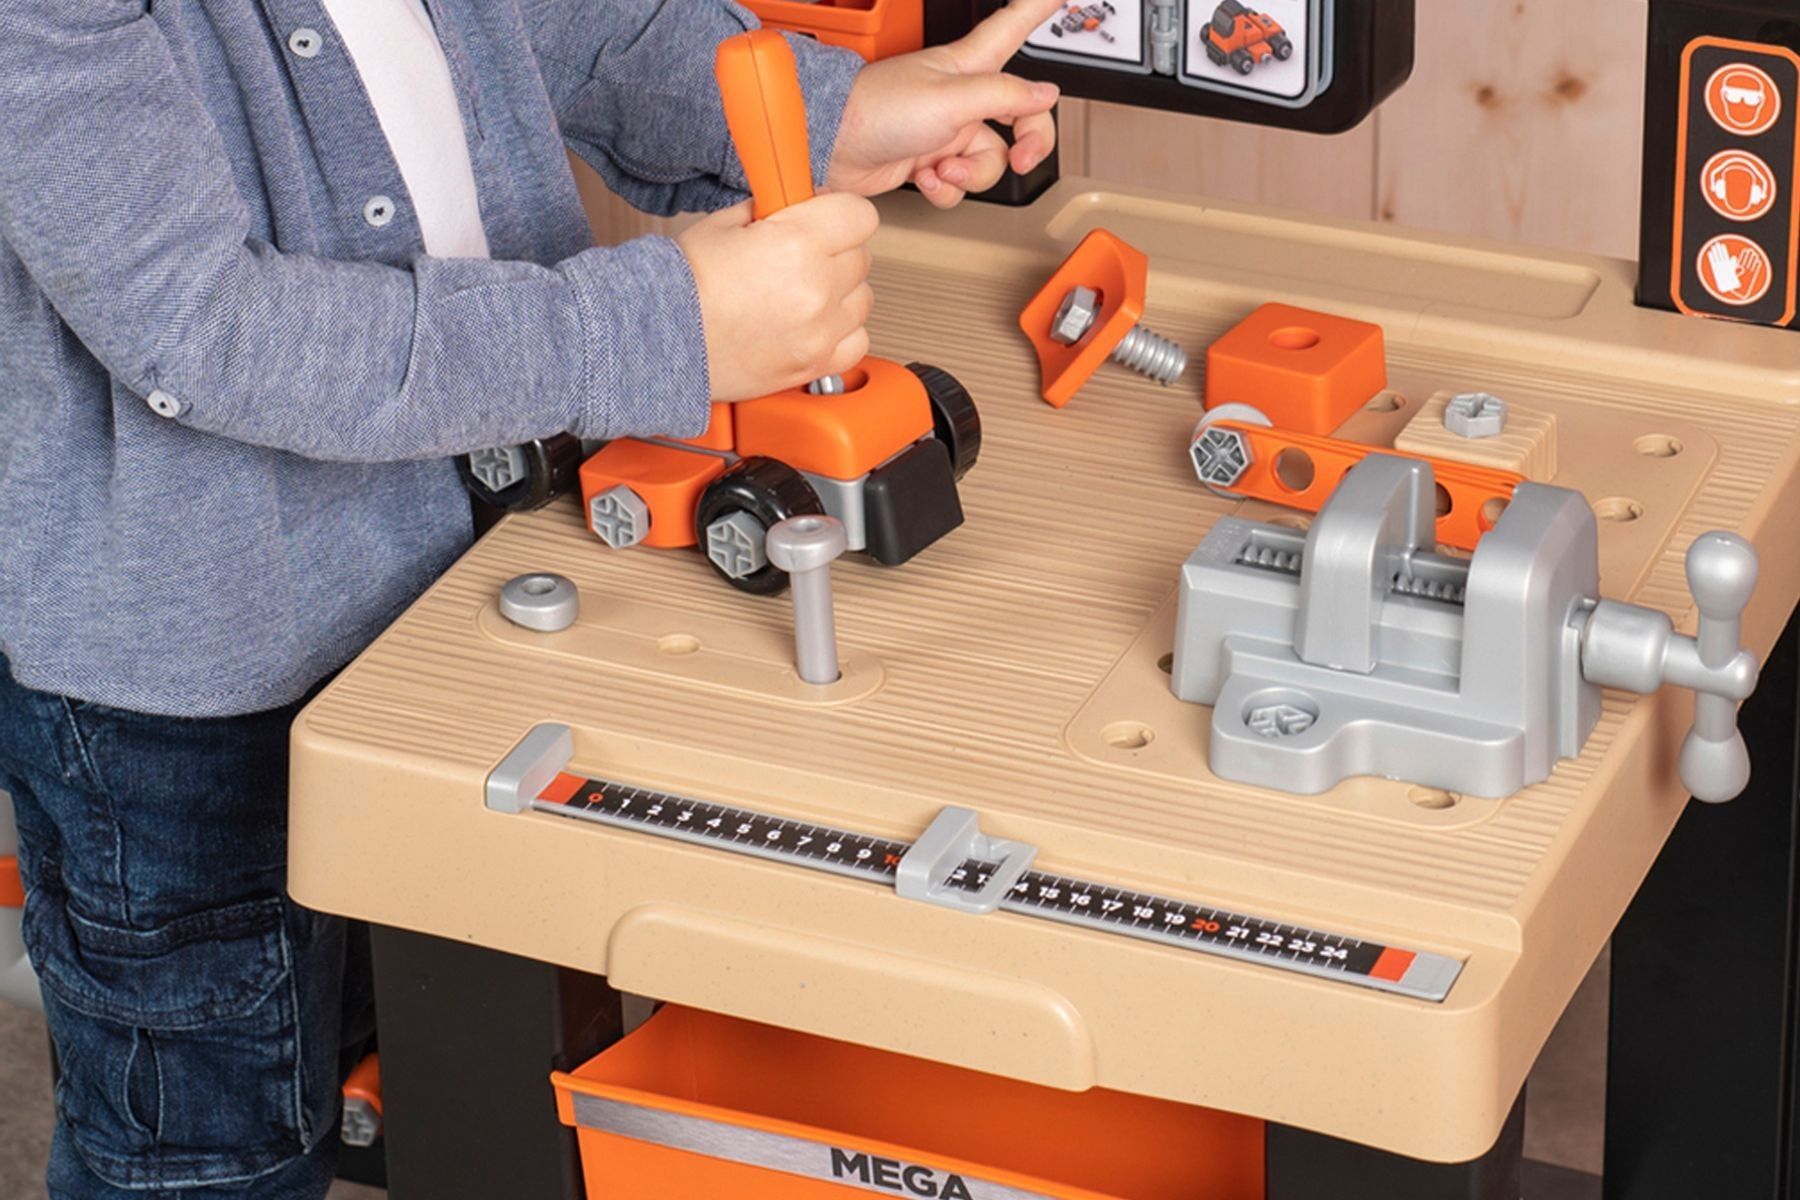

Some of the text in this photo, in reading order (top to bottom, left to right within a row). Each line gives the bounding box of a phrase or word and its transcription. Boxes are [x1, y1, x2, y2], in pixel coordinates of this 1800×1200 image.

[587, 792, 604, 803] 0
[620, 798, 632, 809] 1
[647, 804, 663, 816] 2
[676, 810, 693, 822] 3
[706, 818, 723, 828] 4
[736, 823, 752, 834] 5
[766, 829, 782, 841] 6
[796, 836, 813, 846] 7
[826, 842, 842, 853] 8
[856, 848, 872, 860] 9
[1038, 886, 1060, 899] 15
[1069, 892, 1091, 906] 16
[1101, 899, 1124, 912] 17
[1132, 905, 1155, 919] 18
[1164, 911, 1187, 925] 19
[1190, 917, 1220, 932] 20
[1225, 926, 1250, 939] 21
[1255, 931, 1284, 947] 22
[1287, 938, 1317, 953] 23
[1319, 945, 1349, 960] 24
[830, 1146, 974, 1200] MEGA
